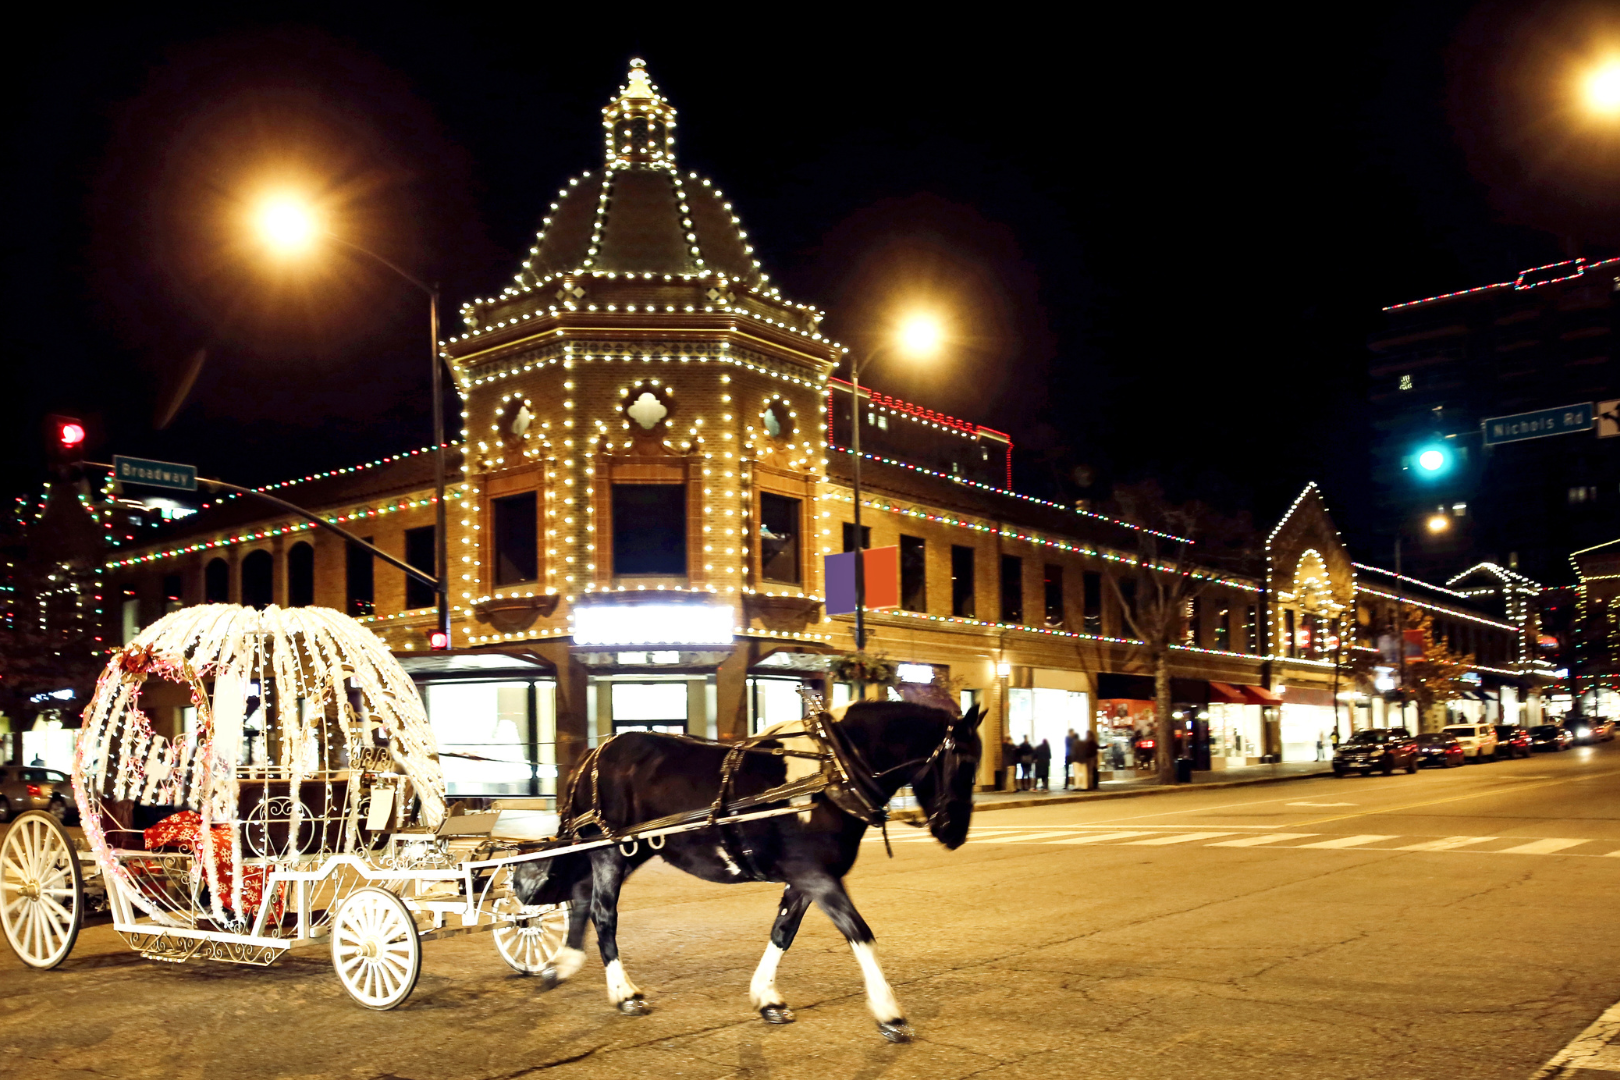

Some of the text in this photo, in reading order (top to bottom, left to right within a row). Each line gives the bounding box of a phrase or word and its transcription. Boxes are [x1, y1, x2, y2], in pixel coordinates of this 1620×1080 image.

[1493, 412, 1584, 437] Nichols Rd
[122, 463, 188, 486] Broadway
